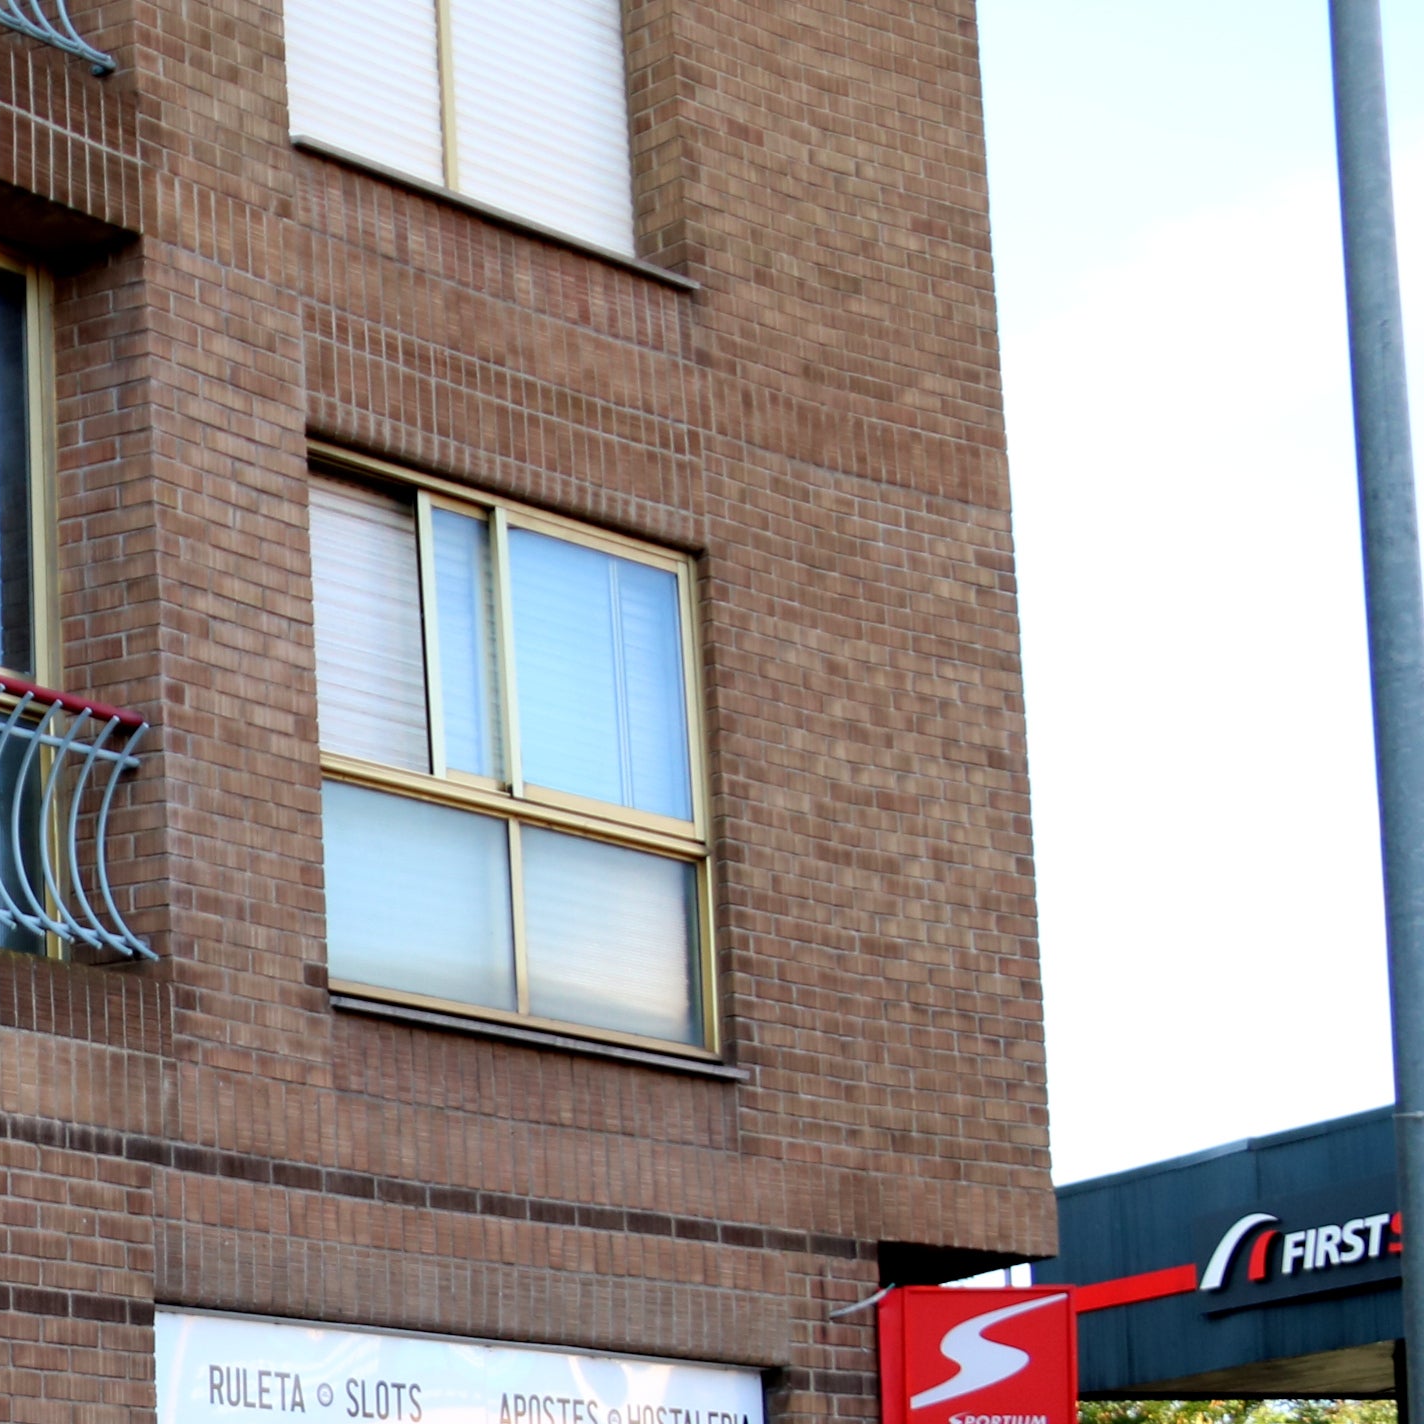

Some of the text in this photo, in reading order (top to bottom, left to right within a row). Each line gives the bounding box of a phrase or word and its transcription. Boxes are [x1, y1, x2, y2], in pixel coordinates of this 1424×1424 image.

[1281, 1212, 1391, 1275] FIRST
[208, 1363, 307, 1414] RULETA
[345, 1377, 424, 1423] SLOTS
